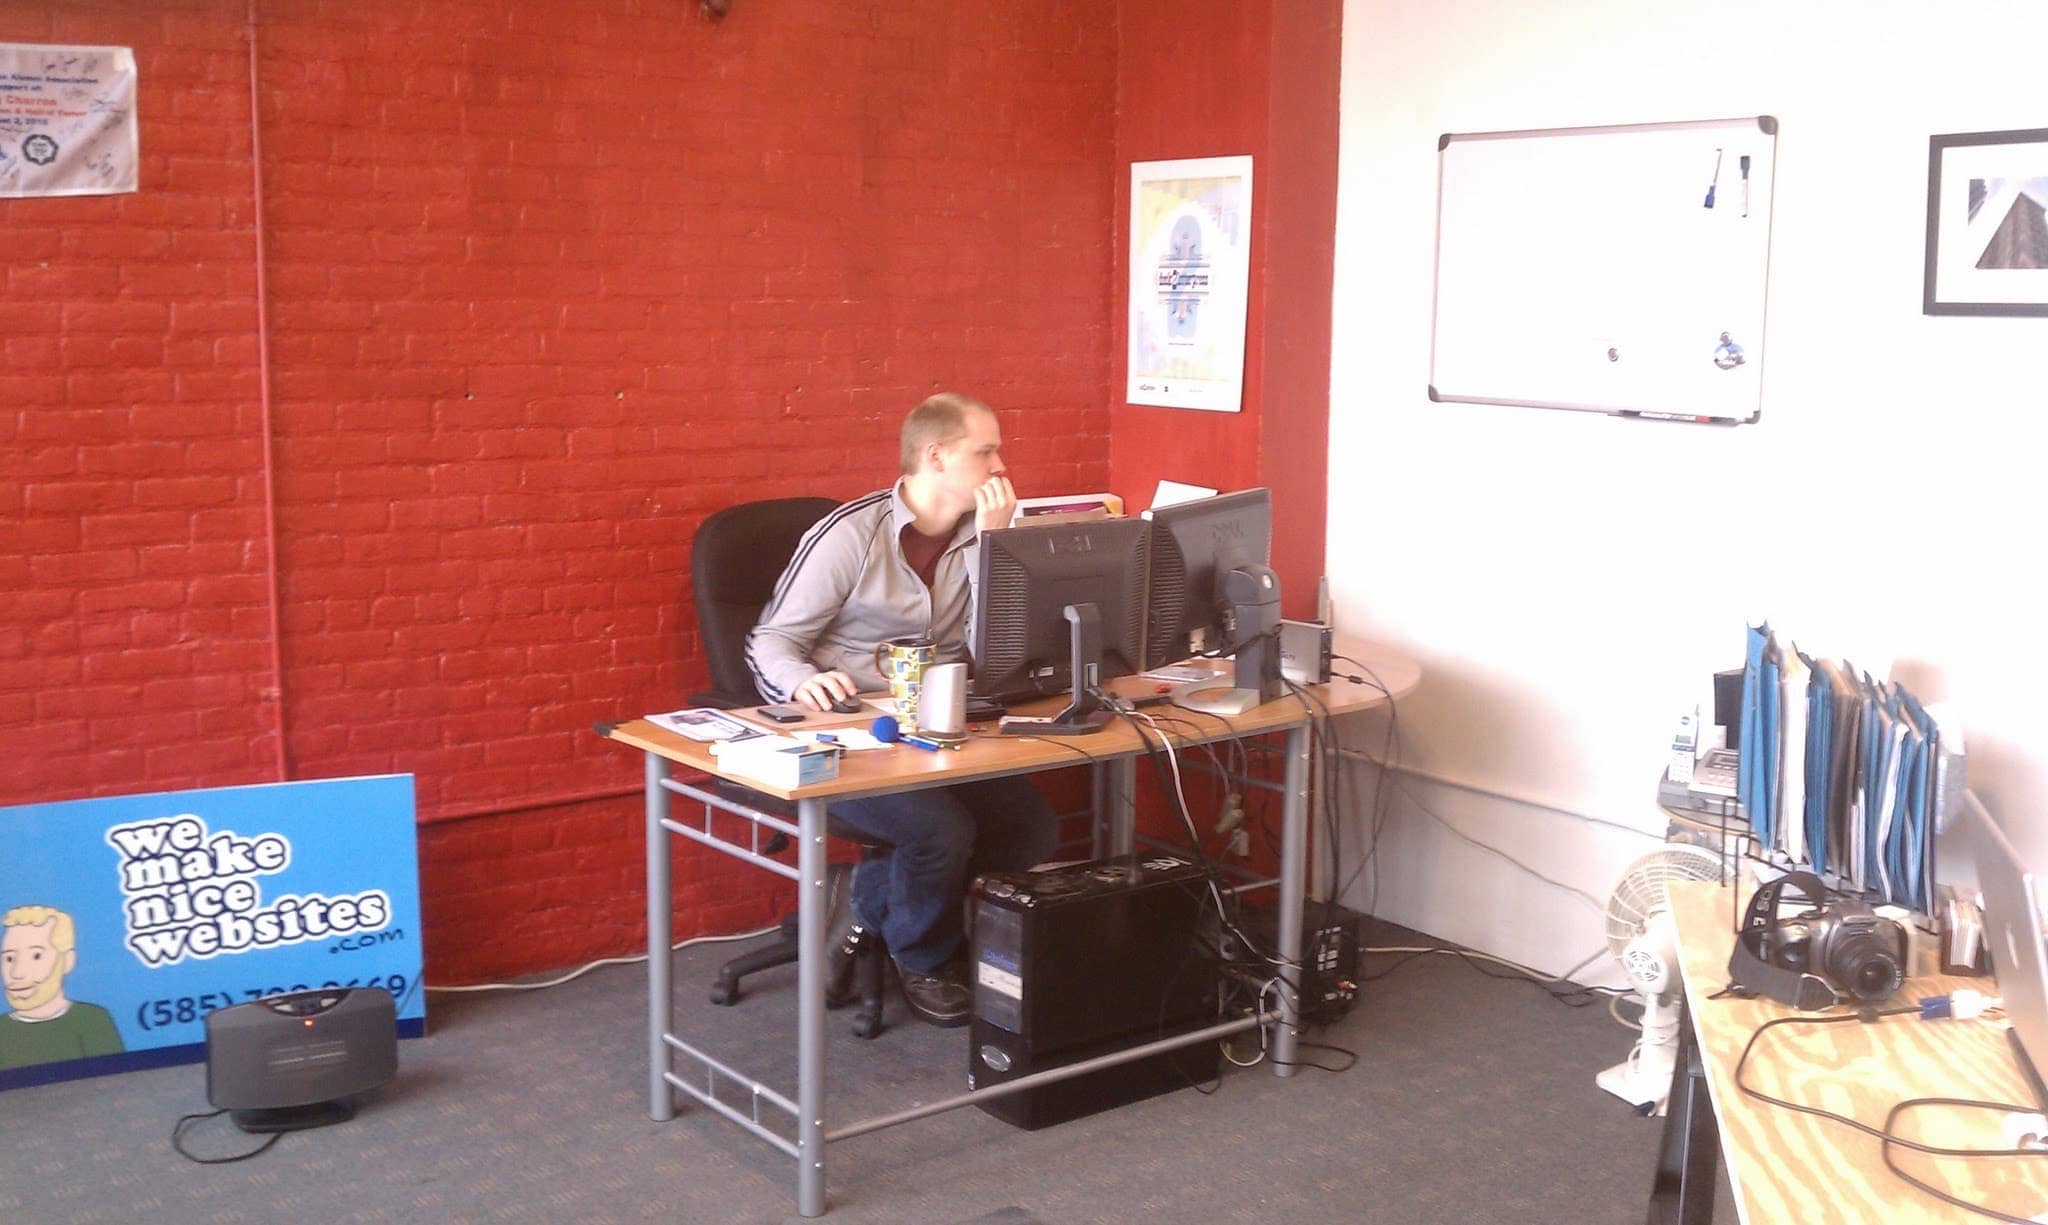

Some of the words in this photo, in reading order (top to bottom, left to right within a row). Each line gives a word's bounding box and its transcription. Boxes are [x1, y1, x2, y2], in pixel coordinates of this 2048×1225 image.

[109, 817, 203, 859] we
[123, 834, 287, 892] make
[127, 880, 257, 930] nice
[129, 893, 389, 964] websites
[328, 927, 405, 954] .com
